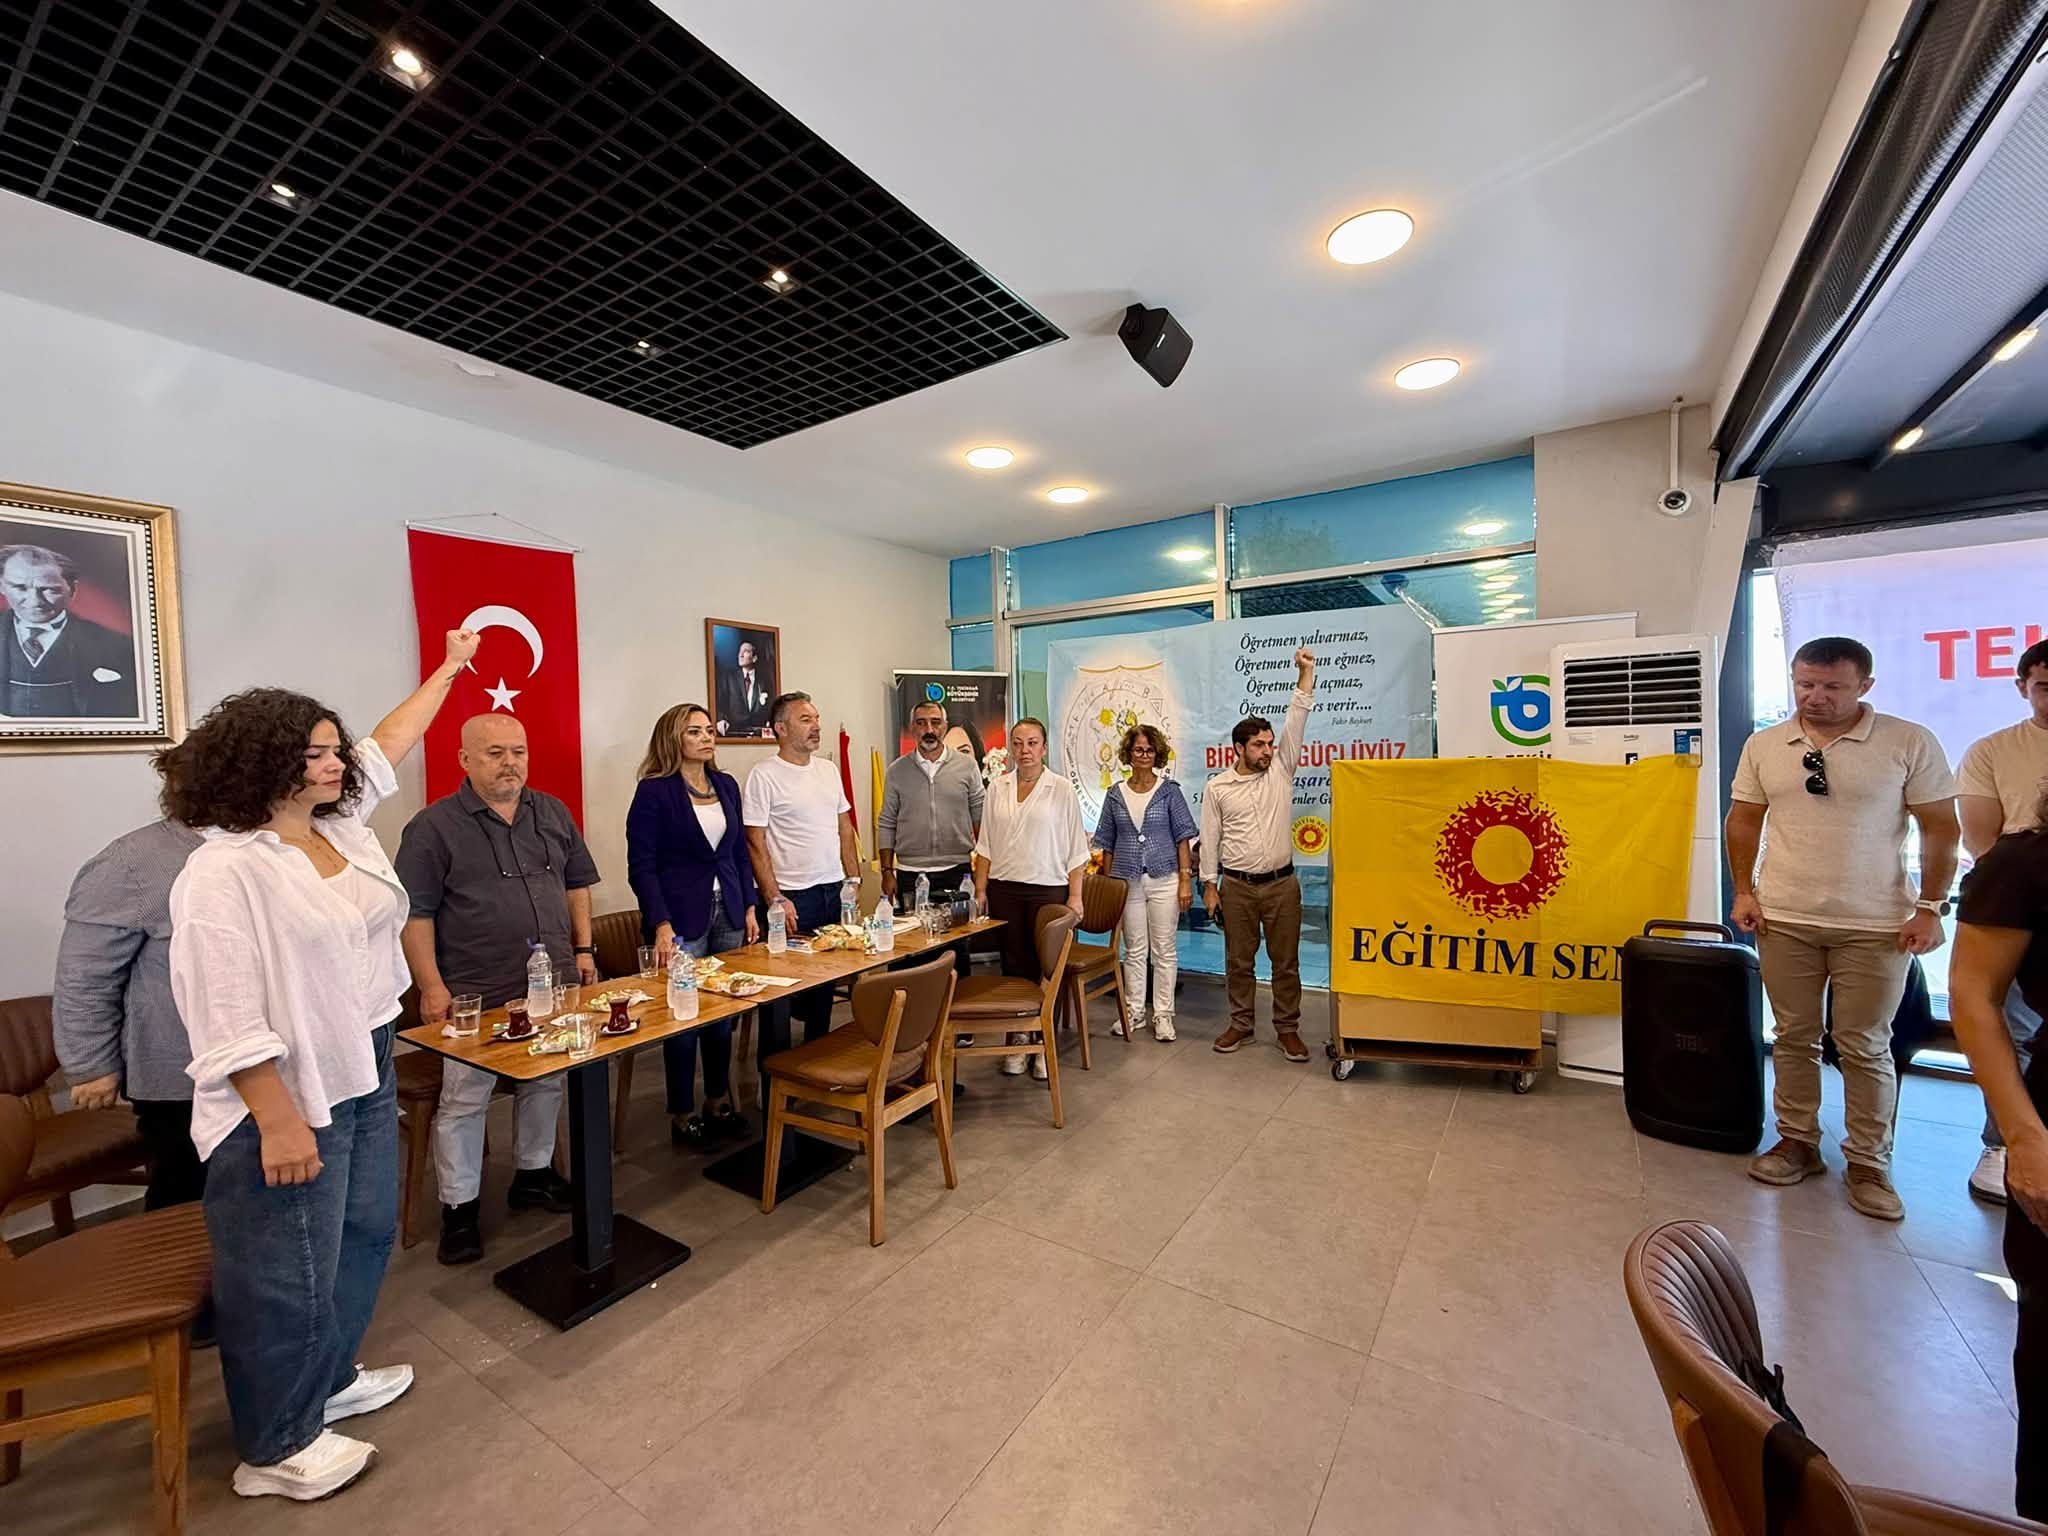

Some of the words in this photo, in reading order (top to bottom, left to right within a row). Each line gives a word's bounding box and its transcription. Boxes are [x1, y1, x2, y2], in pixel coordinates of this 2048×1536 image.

[1240, 632, 1297, 653] Öğretmen
[1300, 629, 1369, 650] yalvarmaz,
[1923, 624, 2048, 681] TE
[1234, 655, 1291, 676] Öğretmen
[1334, 652, 1376, 670] eğmez,
[1246, 676, 1299, 698] Öğretme
[1319, 677, 1364, 694] açmaz,
[1239, 698, 1289, 716] Öğretme
[1349, 920, 1540, 978] EĞİTİM
